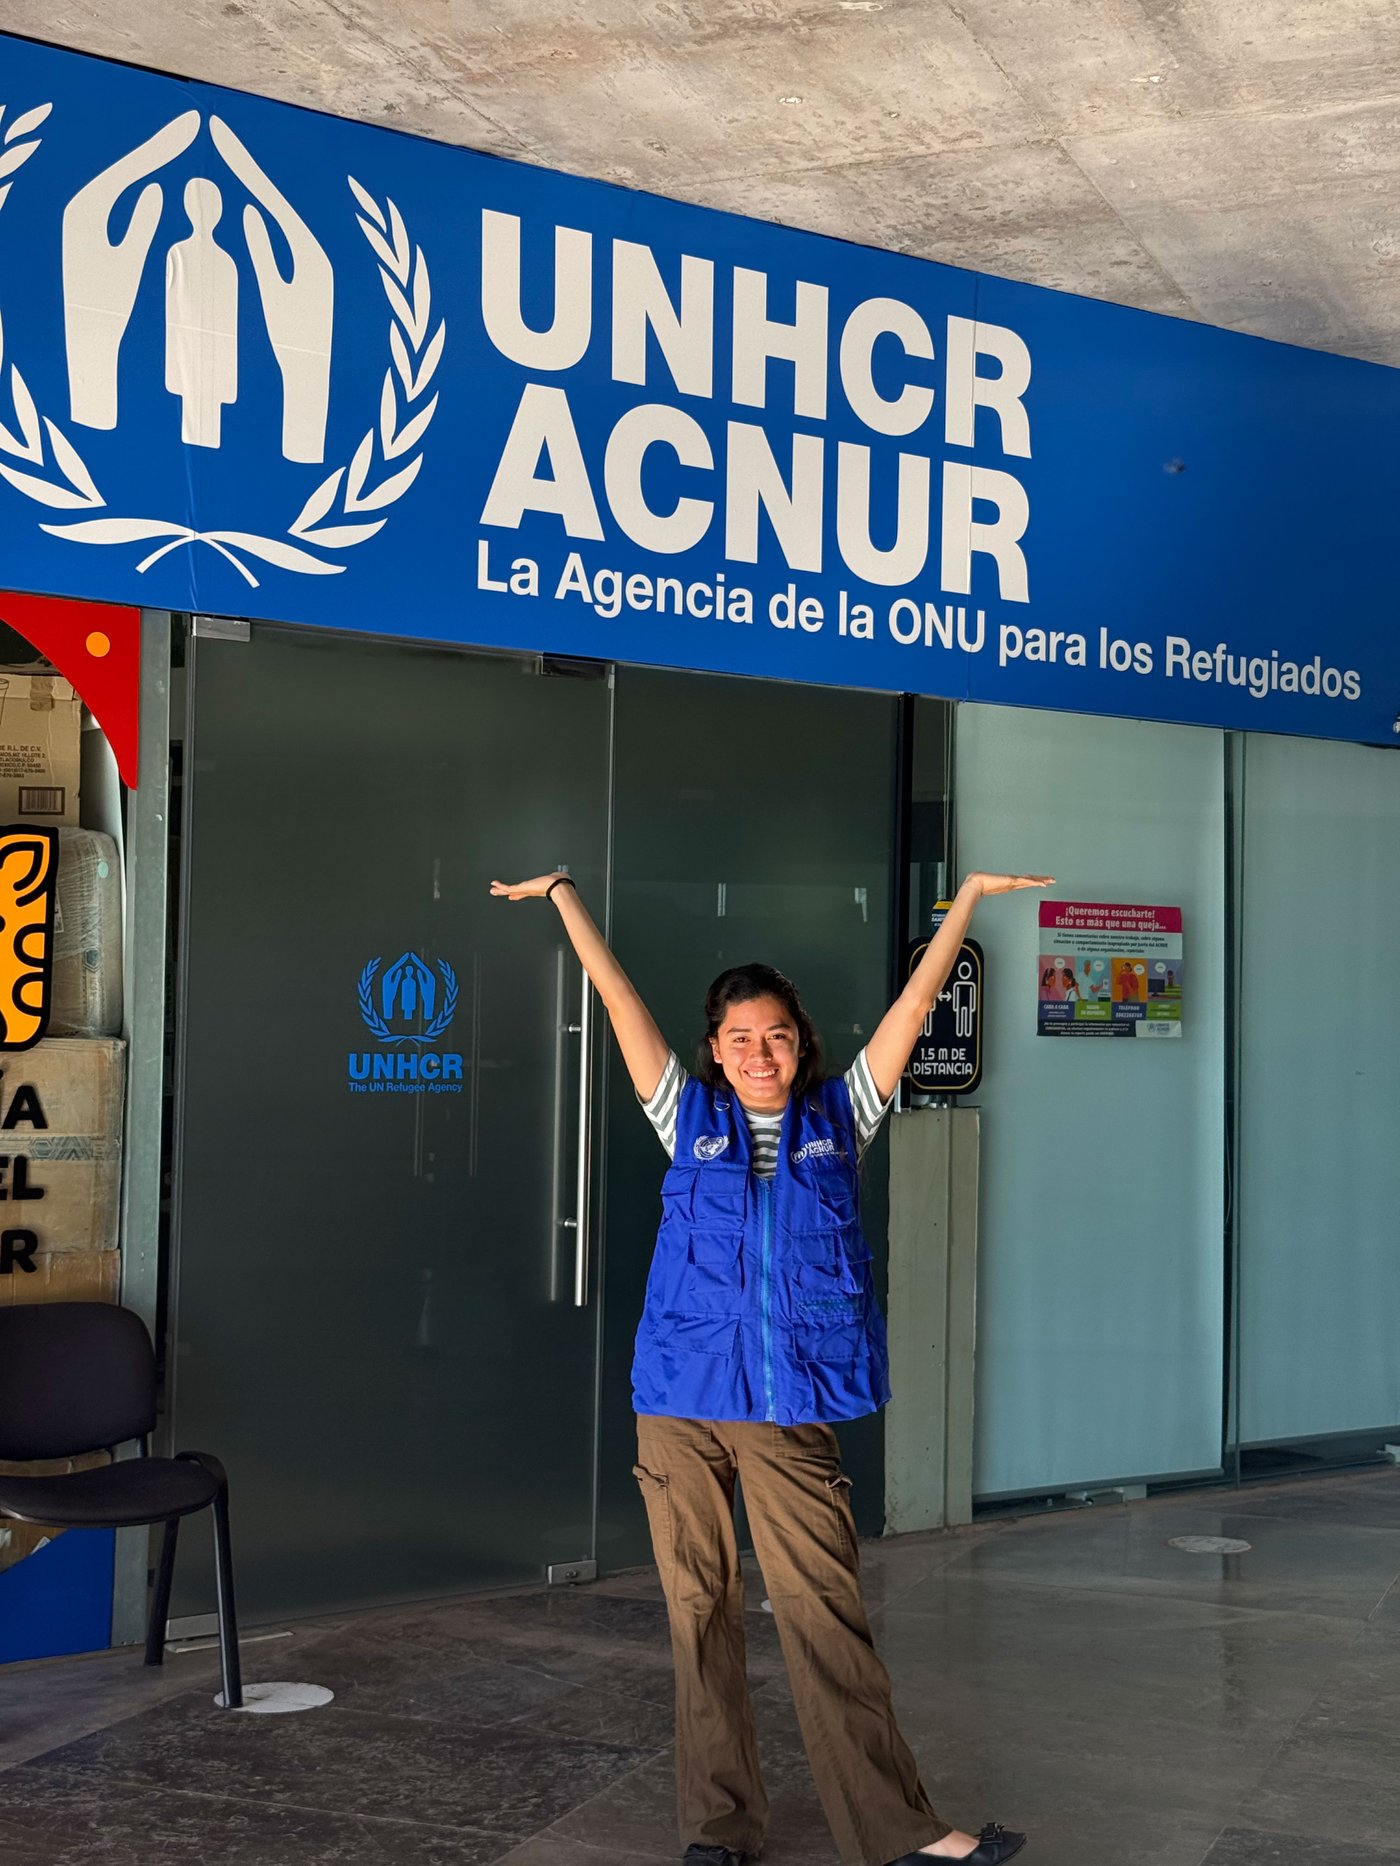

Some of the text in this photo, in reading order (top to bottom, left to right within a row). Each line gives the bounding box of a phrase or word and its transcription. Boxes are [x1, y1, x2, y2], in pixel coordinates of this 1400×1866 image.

[480, 208, 1032, 459] UNHCR
[479, 383, 1030, 604] ACNUR
[477, 539, 1361, 700] La Agencia de la ONU para los Refugiados
[1055, 915, 1074, 926] Esto
[1075, 918, 1085, 926] es
[1086, 917, 1104, 927] más
[1105, 920, 1120, 930] que
[1121, 920, 1136, 929] una
[920, 1047, 935, 1060] 1.5
[951, 1047, 967, 1060] DE
[348, 1052, 463, 1080] UNHCR
[913, 1062, 973, 1075] DISTANCIA
[348, 1082, 463, 1094] The UN Refugee Agency
